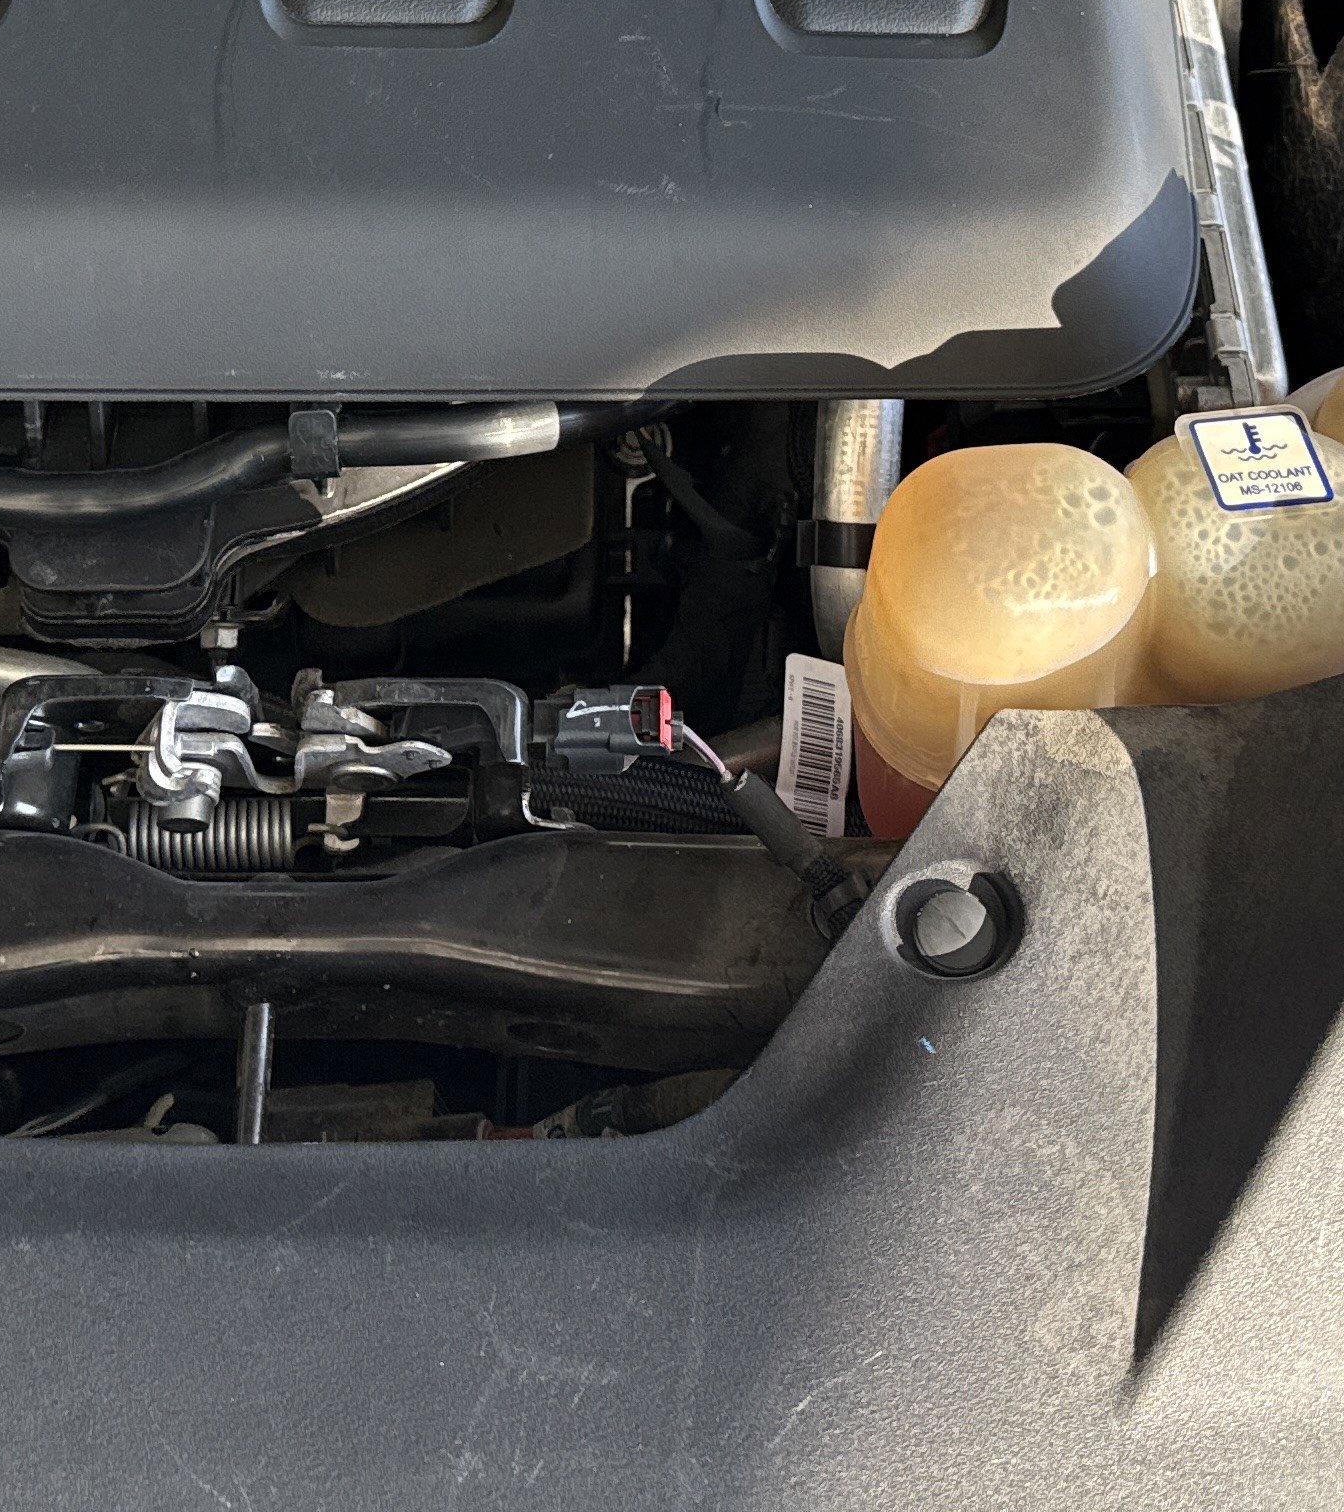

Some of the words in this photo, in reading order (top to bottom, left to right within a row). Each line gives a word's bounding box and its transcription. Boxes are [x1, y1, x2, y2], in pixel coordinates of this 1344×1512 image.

[1218, 471, 1244, 484] OAT
[1247, 465, 1312, 481] COOLANT
[1238, 481, 1304, 496] MS-12106
